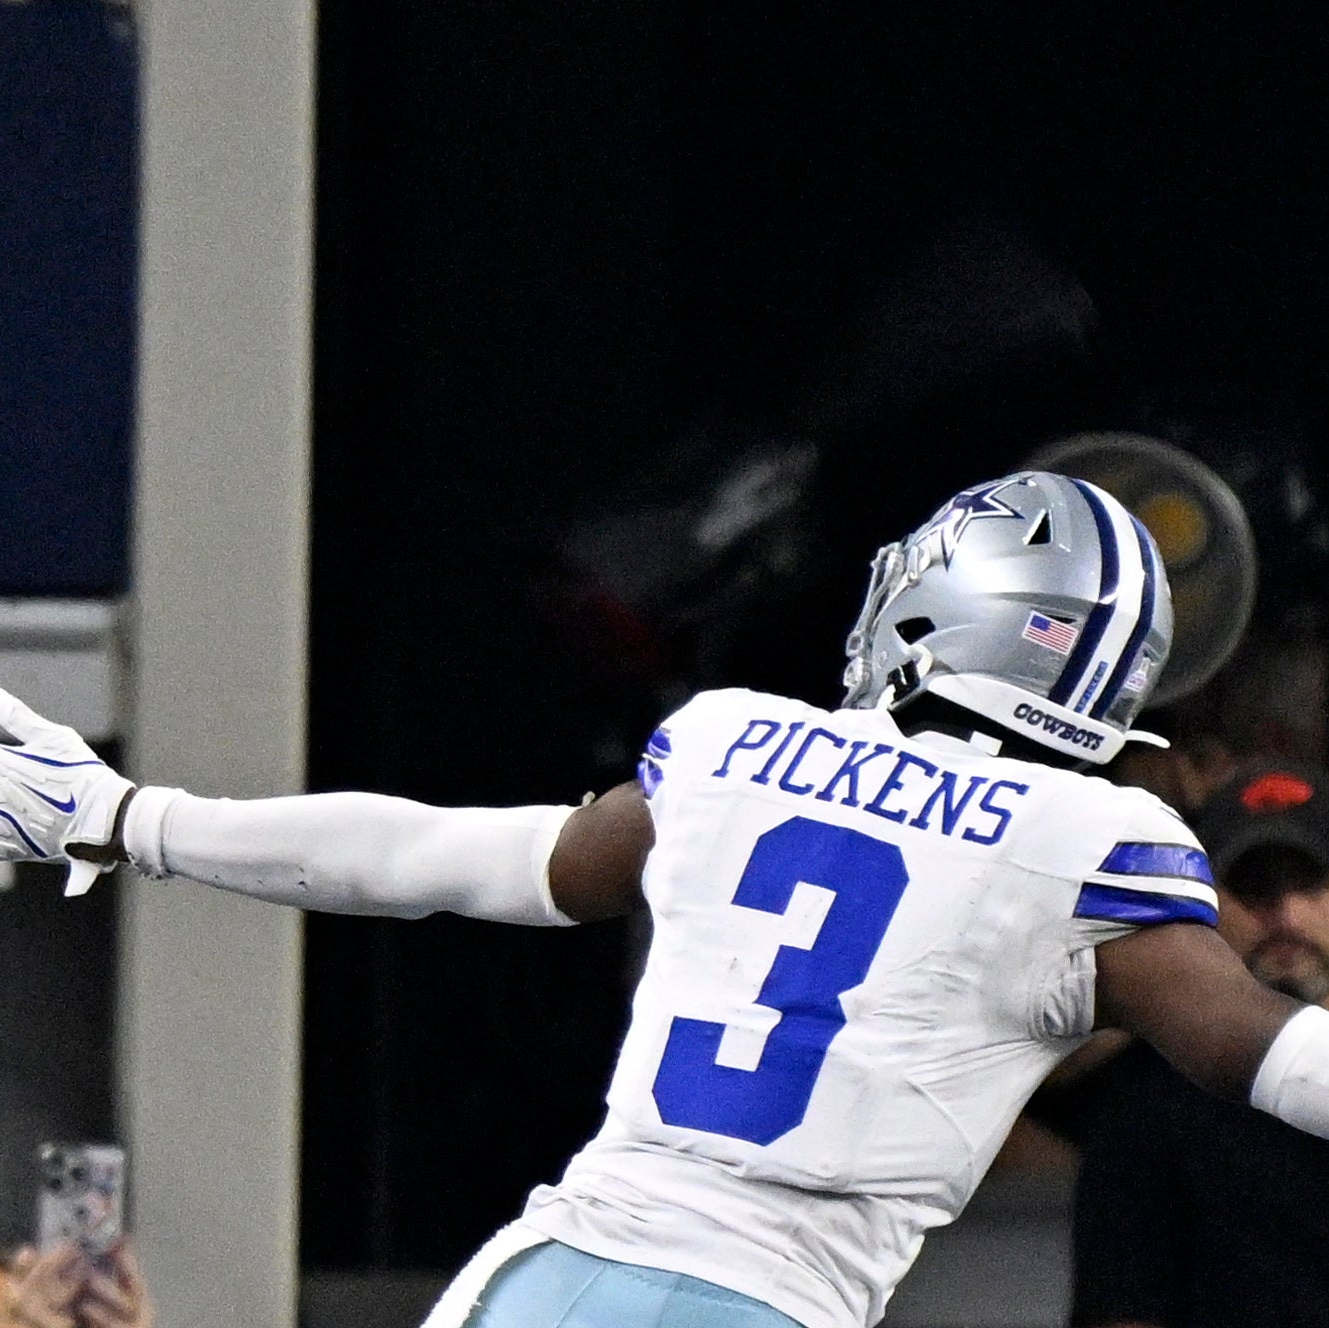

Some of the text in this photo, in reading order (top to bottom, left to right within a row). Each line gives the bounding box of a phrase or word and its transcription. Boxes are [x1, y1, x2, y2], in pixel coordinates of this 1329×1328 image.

[711, 719, 1030, 846] PICKENS
[1013, 702, 1106, 751] COWBOYS
[651, 815, 910, 1147] 3
